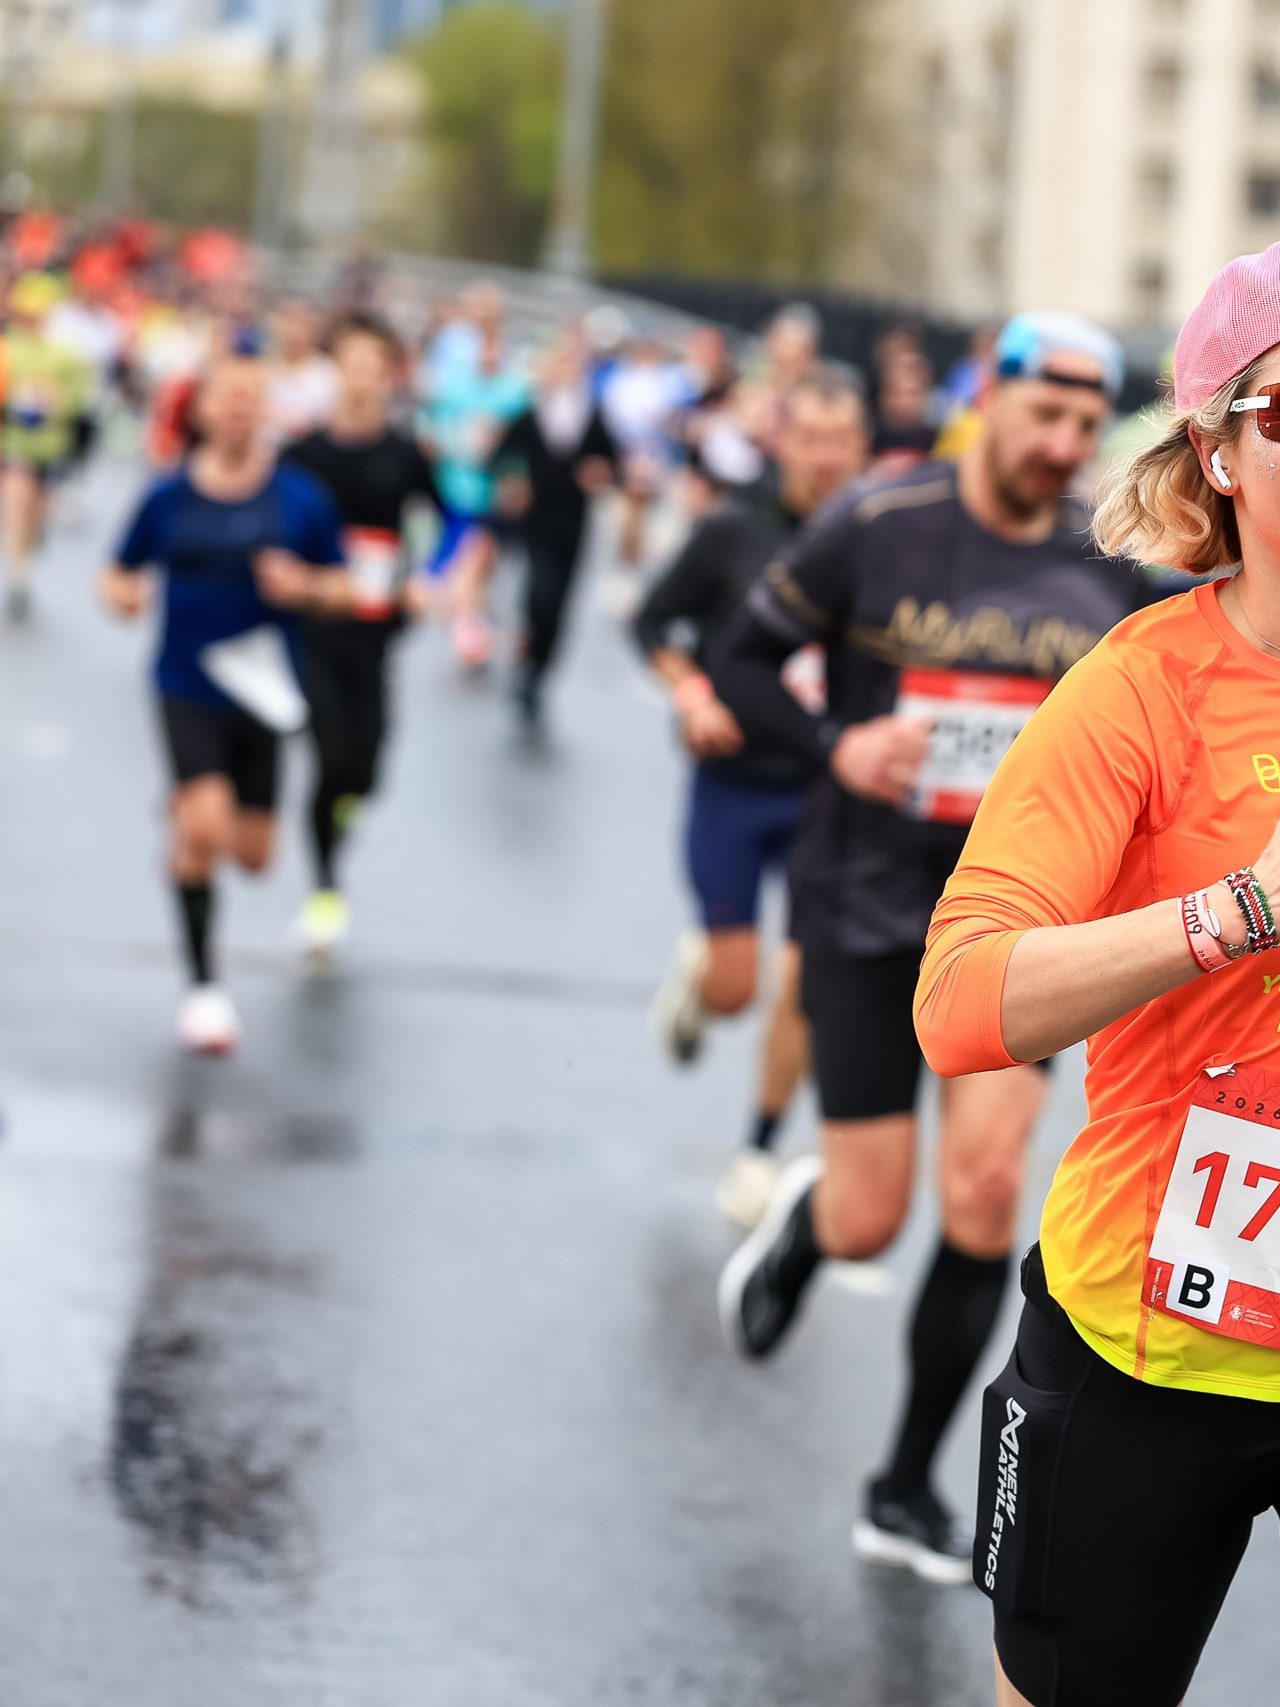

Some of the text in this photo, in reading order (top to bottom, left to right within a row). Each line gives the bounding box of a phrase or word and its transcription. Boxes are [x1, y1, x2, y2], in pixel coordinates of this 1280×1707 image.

[1183, 893, 1203, 935] 7709
[1178, 1264, 1215, 1309] B
[985, 1442, 1009, 1591] ATHLETICS
[1005, 1453, 1019, 1526] NEW
